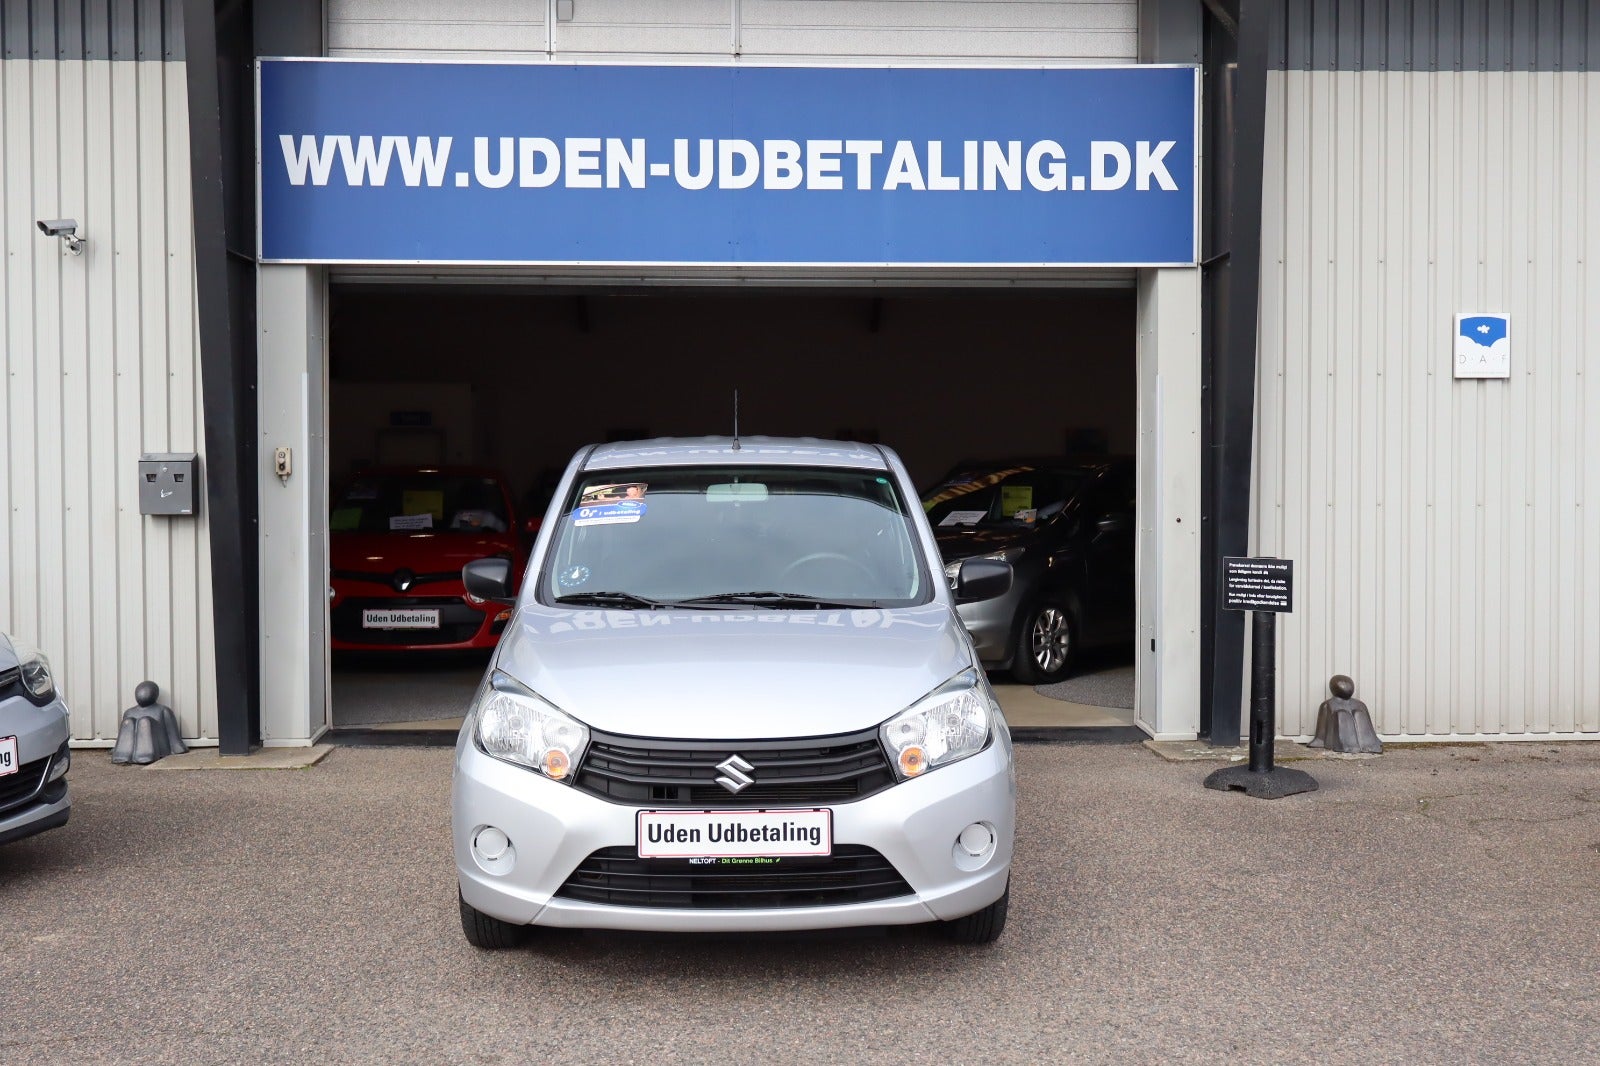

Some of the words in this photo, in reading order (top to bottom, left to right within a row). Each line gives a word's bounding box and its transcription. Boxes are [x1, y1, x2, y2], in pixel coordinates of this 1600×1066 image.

[279, 134, 1179, 192] WWW.UDEN-UDBETALING.DK
[366, 614, 388, 623] Uden
[390, 614, 436, 624] Udbetaling
[648, 823, 701, 843] Uden
[708, 822, 821, 846] Udbetaling
